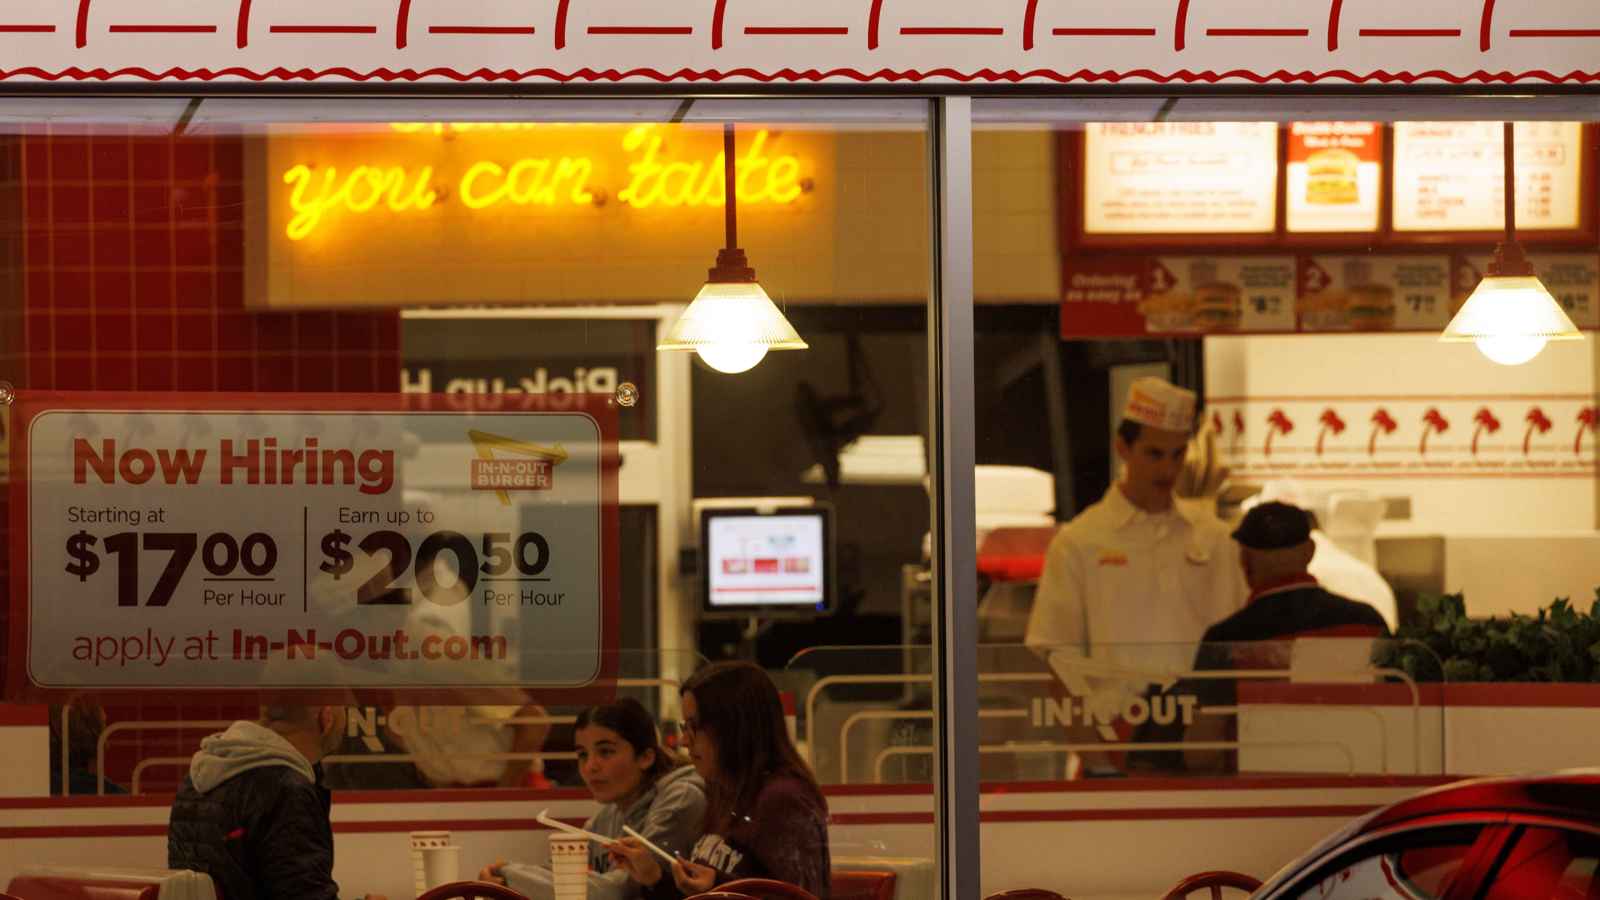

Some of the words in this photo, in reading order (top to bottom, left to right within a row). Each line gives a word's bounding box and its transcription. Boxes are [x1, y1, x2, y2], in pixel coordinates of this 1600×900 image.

[283, 164, 436, 241] you
[459, 157, 593, 209] can
[617, 122, 802, 209] taste
[73, 438, 207, 485] Now
[220, 437, 394, 495] Hiring
[478, 461, 547, 474] IN-N-OUT
[477, 474, 549, 487] BURGER
[67, 506, 141, 526] Starting
[147, 508, 165, 523] at
[339, 507, 380, 524] Earn
[386, 510, 410, 529] up
[416, 509, 435, 524] to
[203, 589, 234, 606] Per
[240, 589, 286, 606] Hour
[484, 589, 514, 606] Per
[520, 589, 566, 606] Hour
[72, 627, 175, 667] apply
[183, 630, 219, 661] at
[232, 628, 508, 661] In-N-Out.com
